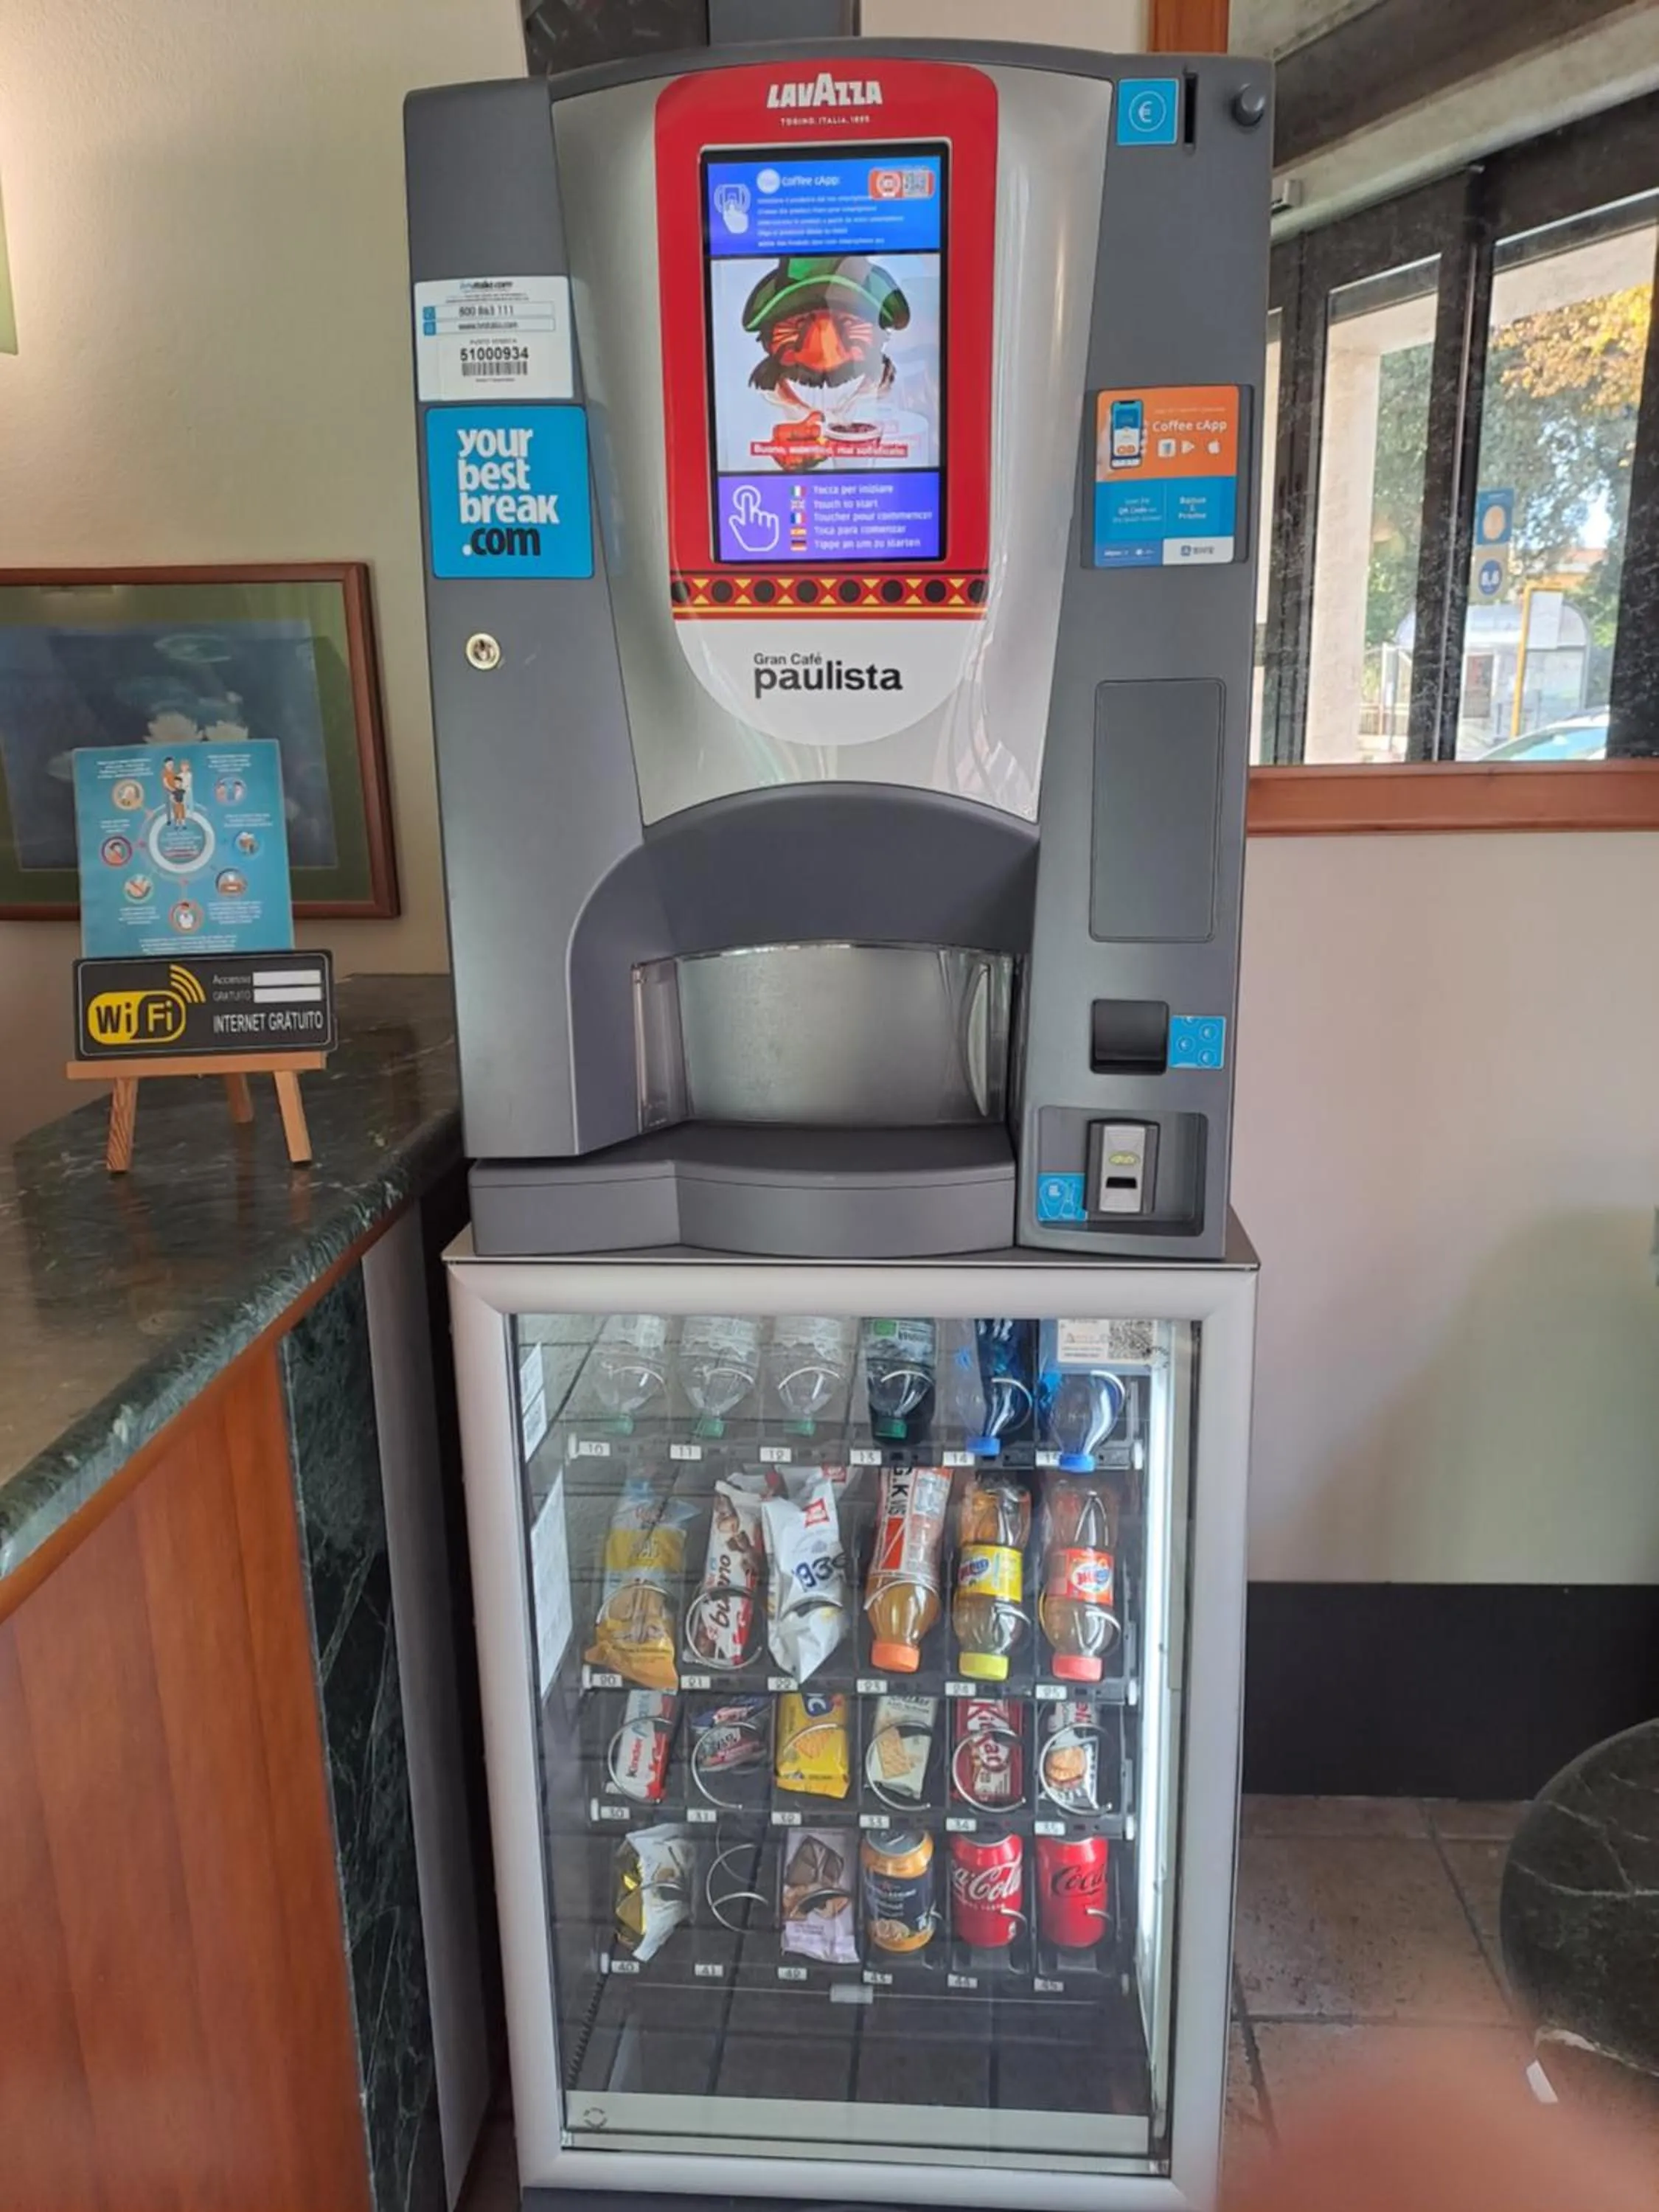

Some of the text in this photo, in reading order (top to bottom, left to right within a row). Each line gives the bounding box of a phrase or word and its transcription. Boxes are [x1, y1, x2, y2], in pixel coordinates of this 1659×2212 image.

[767, 72, 883, 108] LAVAZZA
[460, 346, 529, 361] 51000934
[1152, 420, 1193, 432] Coffee
[457, 428, 533, 458] your
[458, 459, 531, 491] best
[460, 493, 560, 524] break
[462, 527, 541, 556] .com
[754, 652, 822, 665] Gran Café
[754, 660, 903, 699] paulista
[213, 1010, 324, 1034] INTERNET GRATUITO
